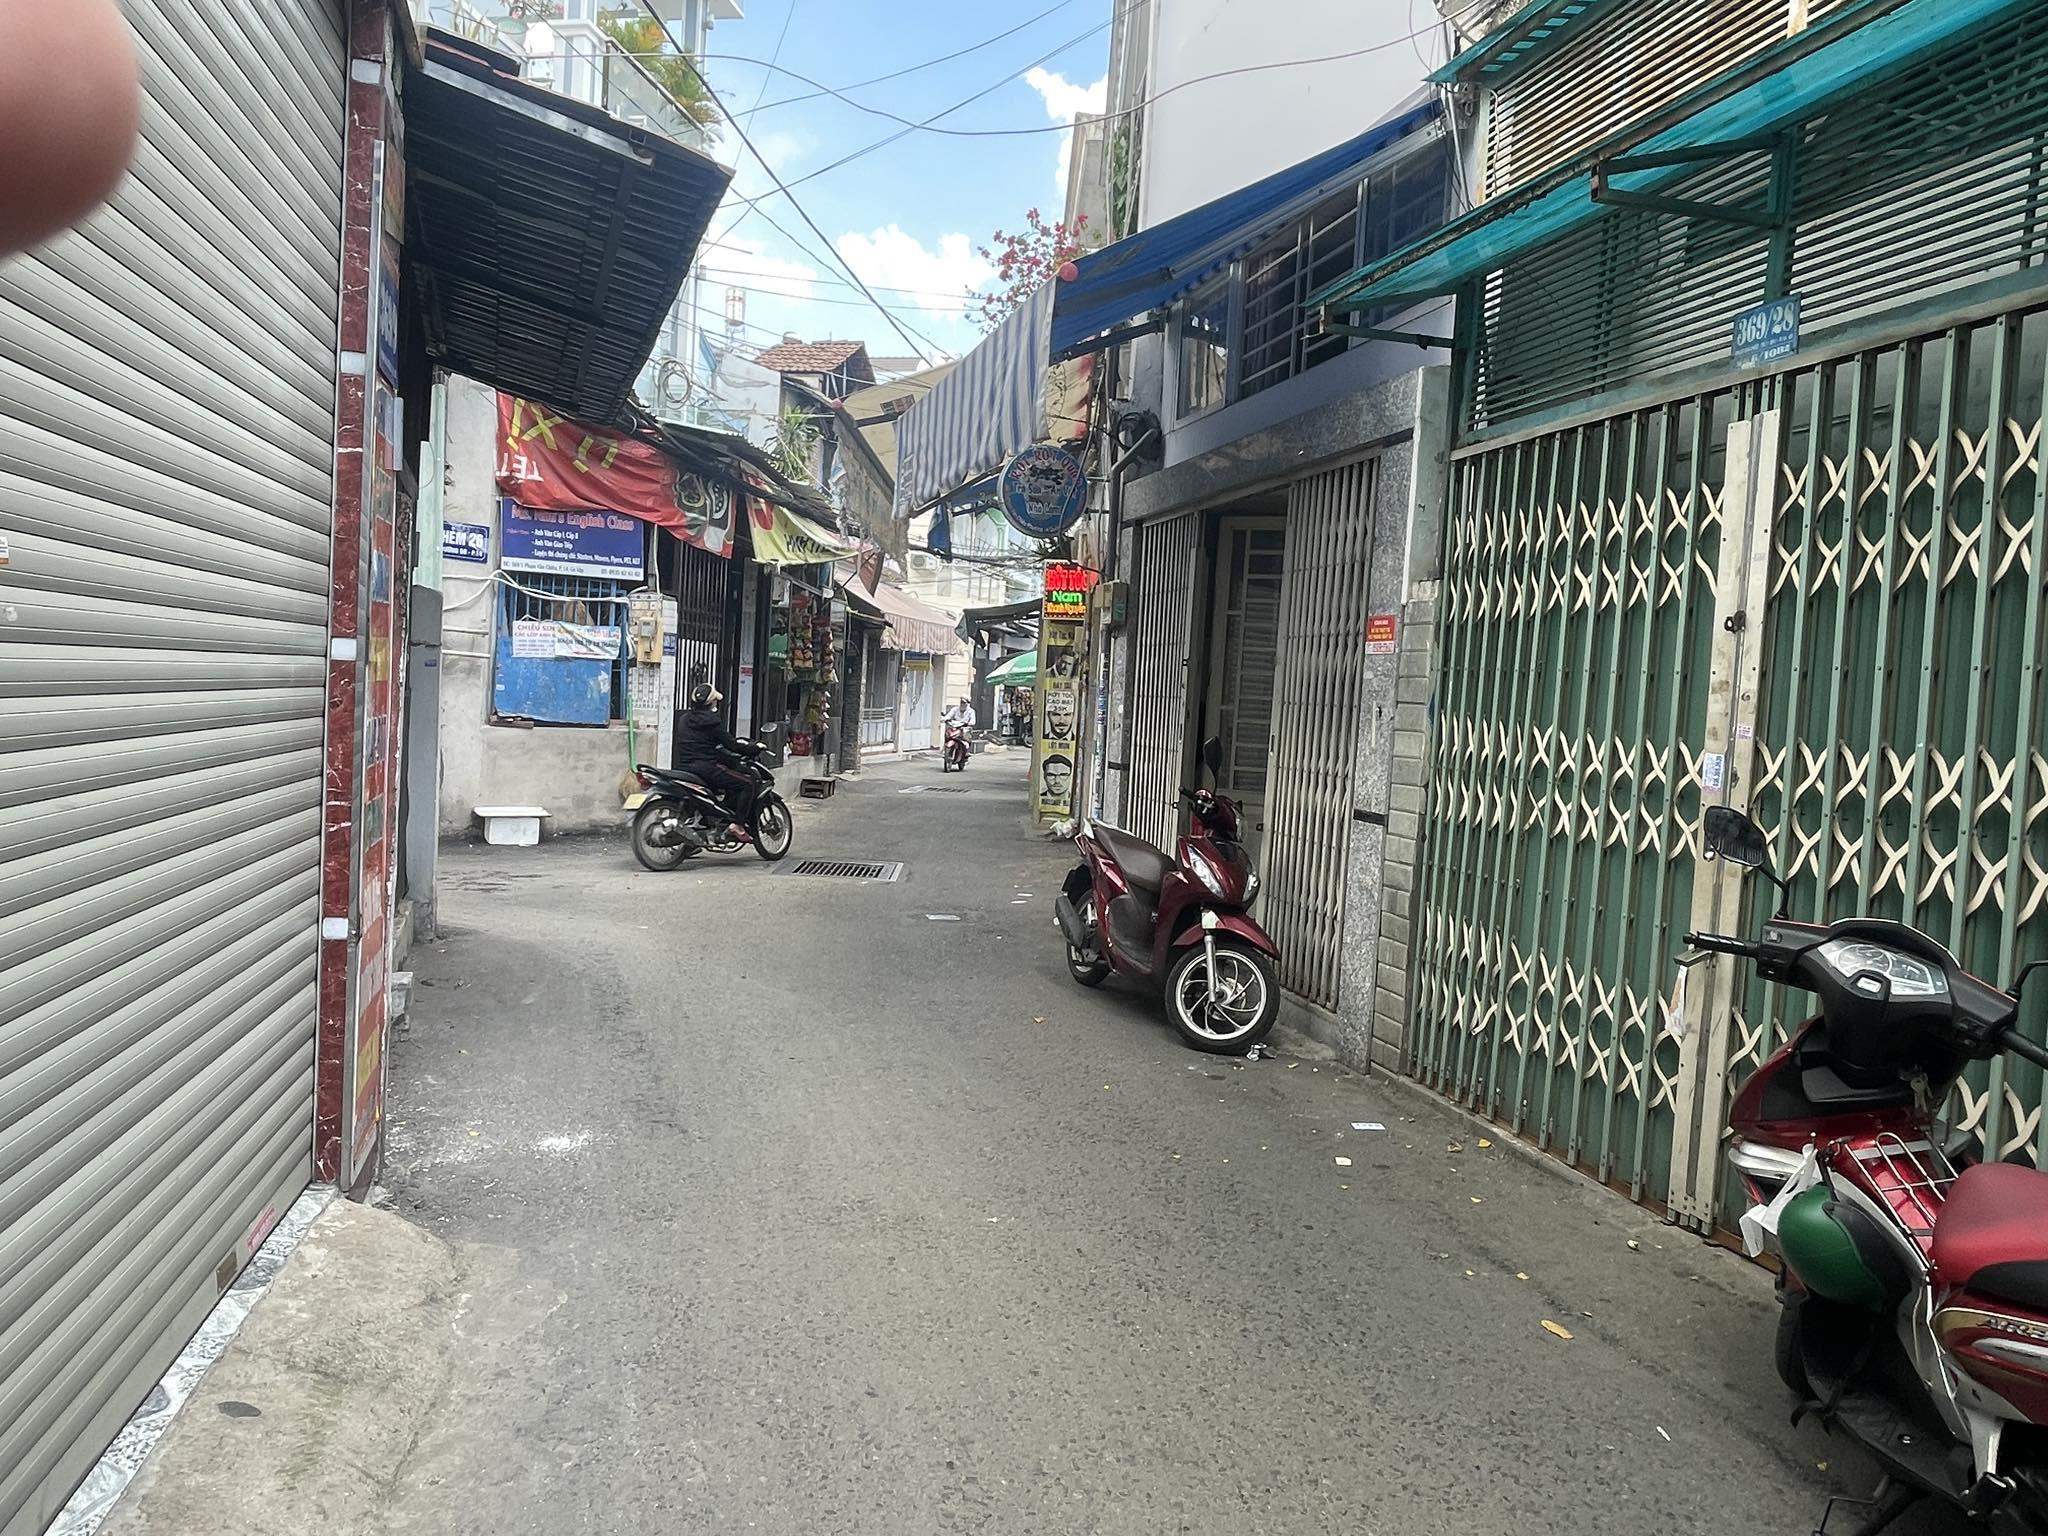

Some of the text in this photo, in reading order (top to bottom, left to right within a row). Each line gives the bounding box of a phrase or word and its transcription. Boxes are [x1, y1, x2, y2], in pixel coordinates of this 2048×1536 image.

[1737, 302, 1794, 346] 369/28
[567, 512, 606, 529] English
[607, 515, 635, 531] Class
[1052, 590, 1083, 602] Nam
